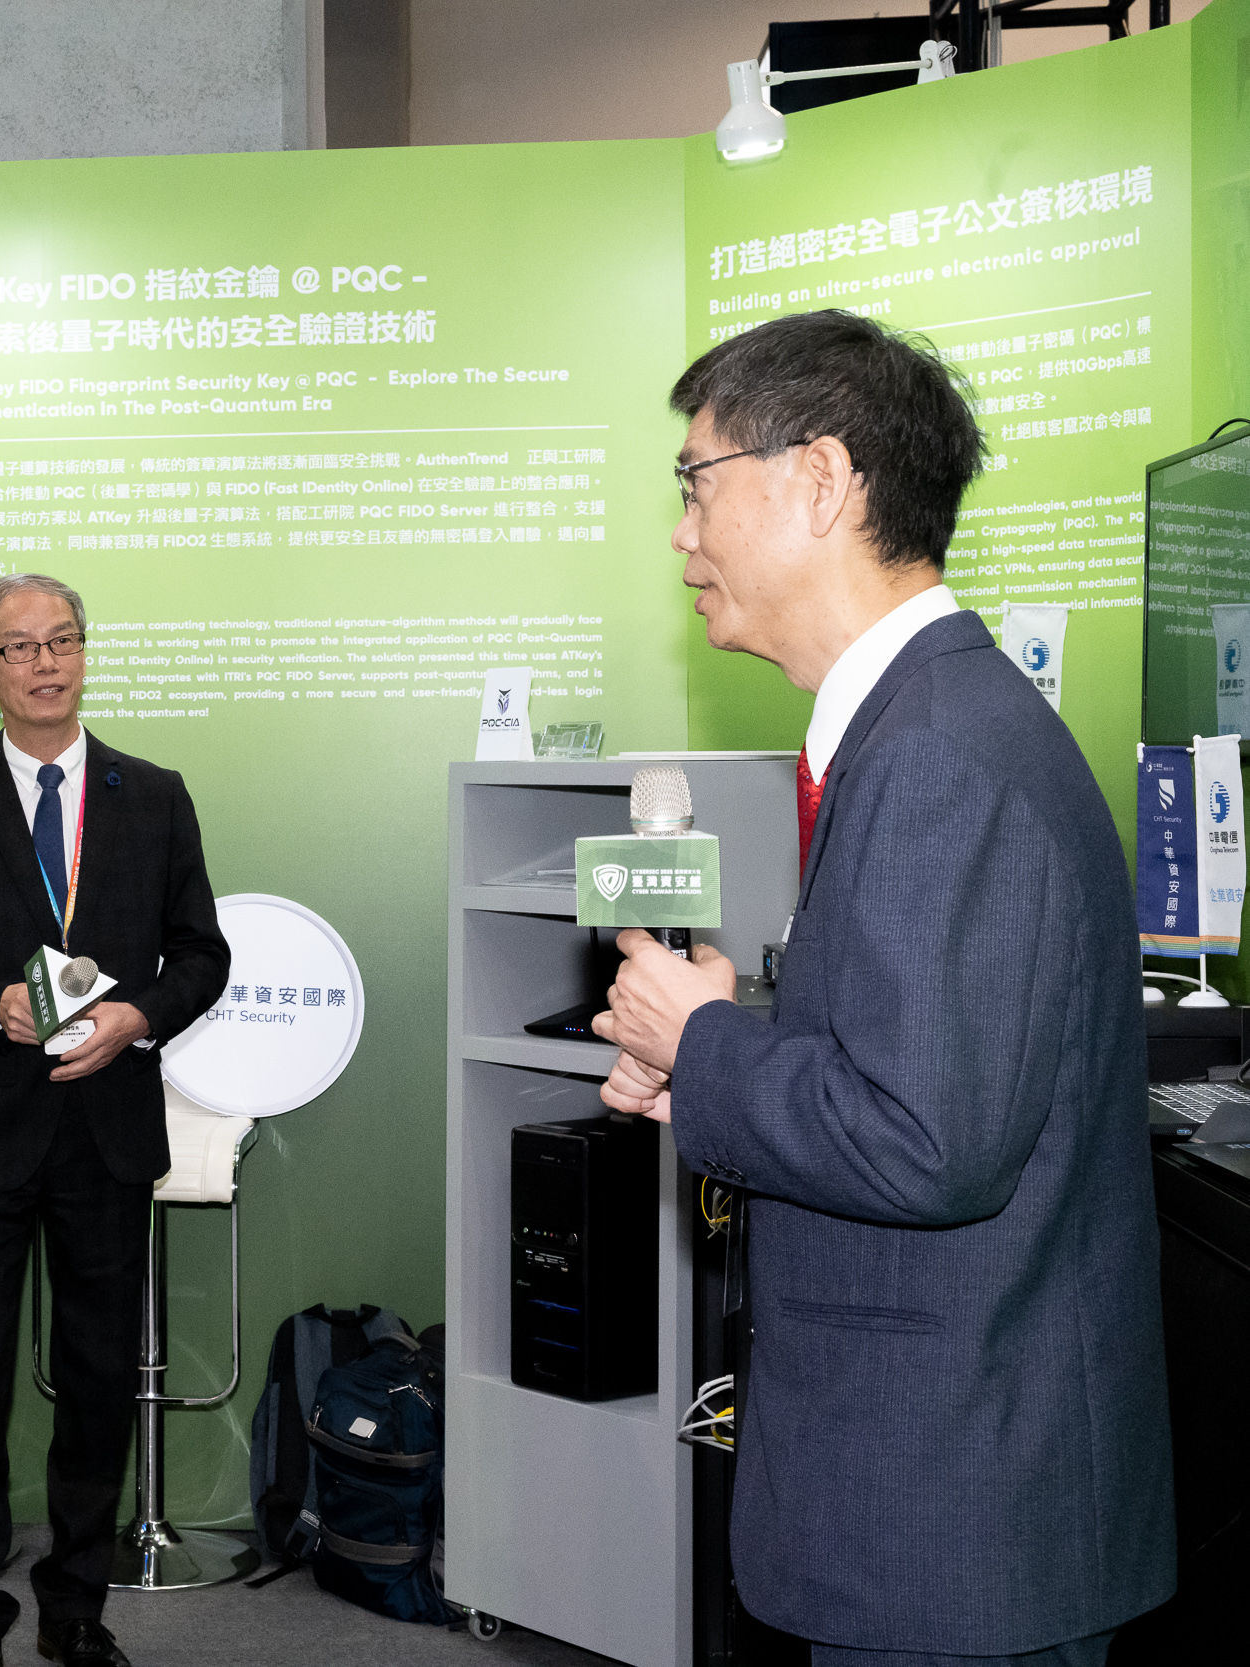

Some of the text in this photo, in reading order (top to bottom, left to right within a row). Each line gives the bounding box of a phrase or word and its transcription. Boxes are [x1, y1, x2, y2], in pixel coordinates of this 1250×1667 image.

[710, 165, 1154, 280] 打造絕密安全電子公文簽核環境
[710, 291, 782, 315] Building
[788, 288, 810, 302] an
[816, 264, 934, 298] ultra-secure
[941, 246, 1043, 279] electronic
[1050, 227, 1140, 262] approval
[60, 274, 137, 301] FIDO
[144, 266, 280, 301] 指紋金鑰
[291, 266, 321, 295] @
[332, 264, 403, 293] PQC
[19, 379, 64, 395] FIDO
[69, 375, 169, 398] Fingerprint
[176, 373, 251, 394] Security
[257, 373, 290, 392] Key
[295, 373, 310, 389] @
[317, 371, 356, 387] PQC
[388, 368, 458, 389] Explore
[464, 368, 499, 383] The
[505, 366, 569, 383] Secure
[123, 399, 156, 416] The
[161, 397, 296, 416] Post-Quantum
[303, 396, 332, 412] Era
[416, 452, 508, 467] AuthenTrend
[54, 486, 85, 499] PQC
[226, 483, 259, 496] FIDO
[264, 482, 298, 497] (Fast
[303, 480, 358, 496] IDentity
[363, 479, 413, 494] Online)
[996, 491, 1142, 516] technologies, and the world
[87, 511, 131, 526] ATKey
[360, 506, 393, 519] PQC
[399, 505, 434, 518] FIDO
[440, 504, 488, 517] Server
[982, 520, 1056, 538] Cryptography
[1105, 515, 1123, 525] The
[163, 534, 206, 547] FIDO2
[992, 533, 1145, 557] high-speed data transmissio
[978, 565, 1001, 577] PQC
[1005, 563, 1035, 575] VPNs,
[1038, 559, 1084, 572] ensuring
[1088, 557, 1112, 569] data
[1005, 576, 1136, 594] transmission mechanism
[1091, 595, 1143, 609] informatio
[97, 615, 603, 632] quantum computing technology, traditional signature-algorithm methods will gradually face
[157, 632, 602, 649] working with ITRI promote the integrated application PQC (Post-Quantum
[99, 655, 124, 667] (Fast
[129, 655, 171, 667] IDentity
[176, 653, 213, 666] Online)
[232, 653, 274, 666] security
[278, 652, 342, 664] verification.
[347, 653, 367, 663] The
[372, 652, 414, 663] solution
[419, 652, 474, 664] presented
[479, 652, 498, 661] this
[503, 652, 527, 661] time
[533, 652, 556, 661] uses
[561, 651, 602, 662] ATKey's
[137, 673, 191, 685] integrates
[197, 673, 219, 682] with
[224, 671, 251, 682] ITRI's
[257, 671, 281, 682] PQC
[286, 670, 313, 681] FIDO
[318, 671, 355, 682] Server,
[361, 671, 409, 682] supports
[567, 669, 589, 678] and
[83, 687, 602, 703] existing FIDO2 ecosystem, providing more secure and user-friendly login
[117, 708, 208, 720] the quantum era!
[482, 718, 520, 727] PQC-CIA
[1164, 829, 1180, 928] 中華資安國際
[230, 985, 346, 1006] 華資安國際
[205, 1009, 296, 1025] CHT Security
